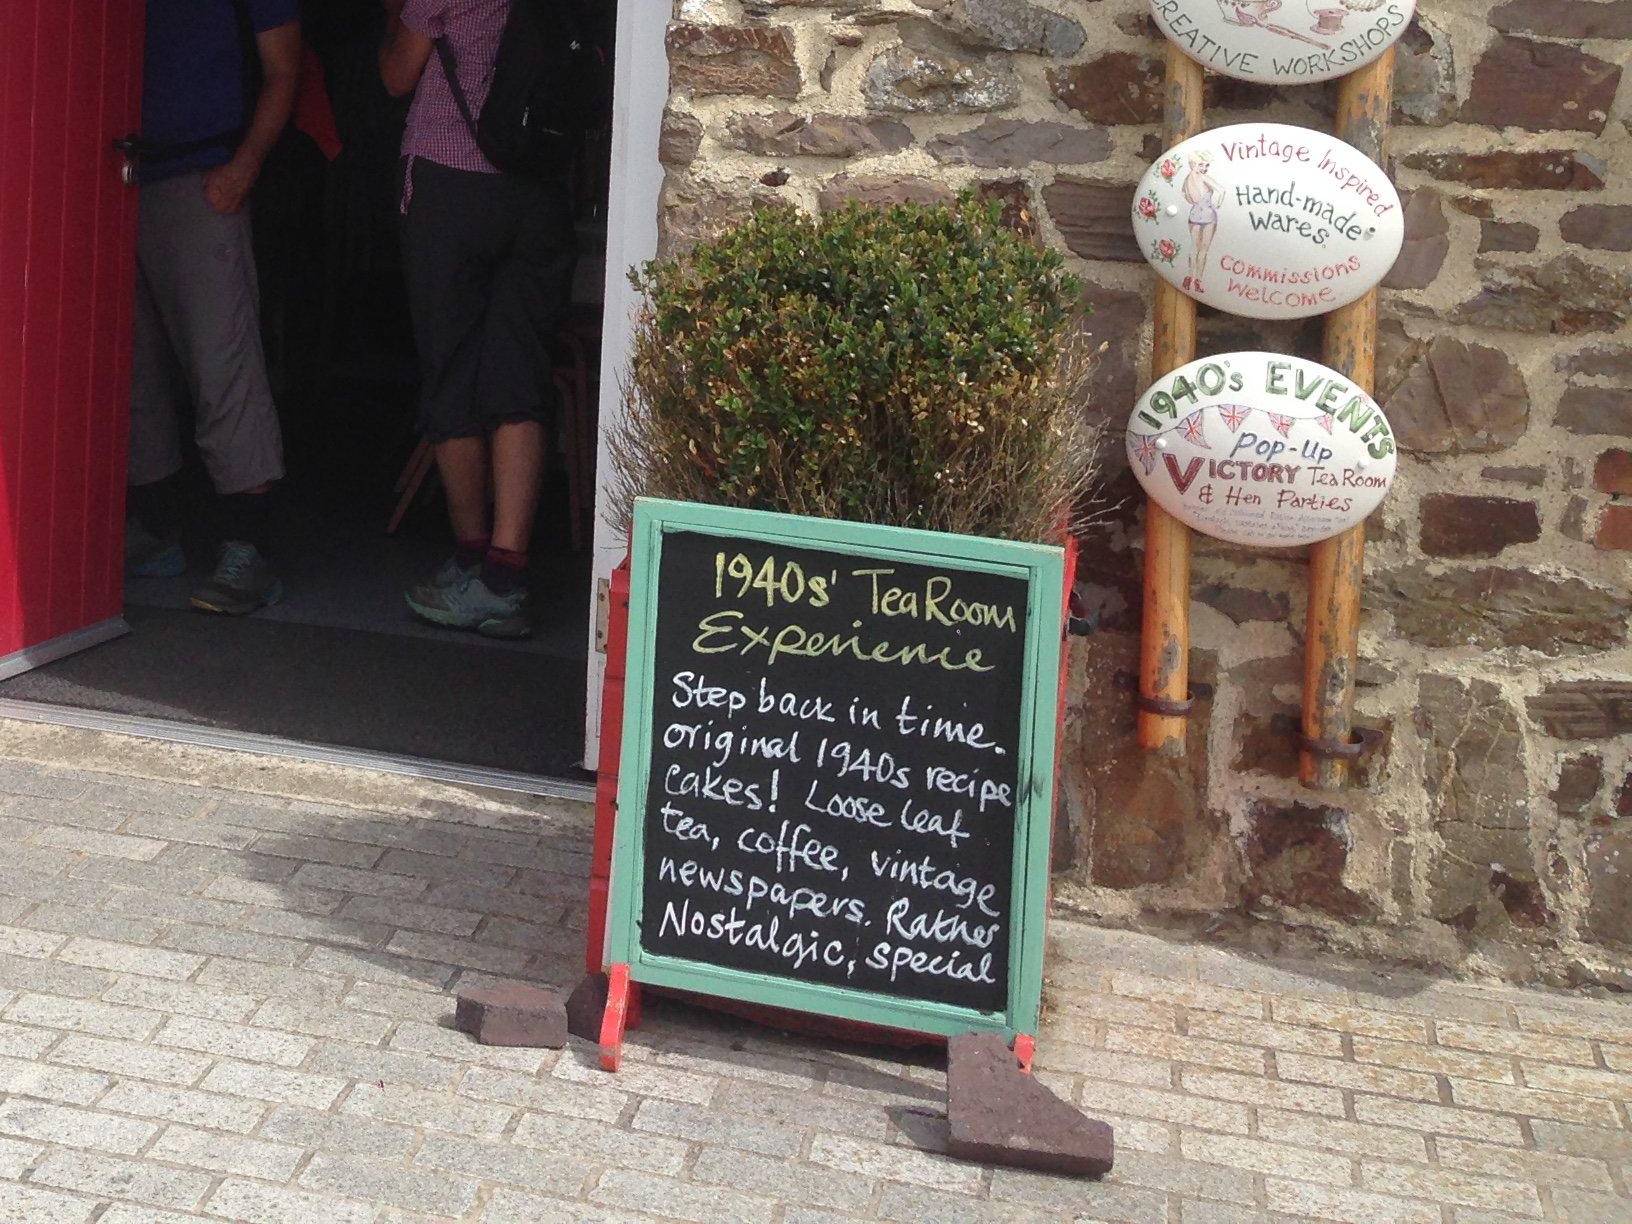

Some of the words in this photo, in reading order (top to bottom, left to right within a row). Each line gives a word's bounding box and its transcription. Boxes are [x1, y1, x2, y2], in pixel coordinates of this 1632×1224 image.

[1273, 5, 1404, 75] WORKSHOPS
[1221, 133, 1310, 162] Vintage
[1317, 149, 1393, 216] Inspired
[1236, 182, 1362, 241] Hand-made
[1265, 361, 1394, 460] EVENTS
[1162, 453, 1301, 495] VICTORY
[1309, 466, 1338, 487] Tea
[1342, 469, 1386, 488] Room
[1226, 485, 1260, 505] Hen
[1277, 490, 1353, 511] Parties
[692, 611, 995, 672] Experience
[671, 671, 746, 717] Step
[759, 676, 835, 722] back
[849, 697, 880, 729] in
[895, 696, 1006, 755] time.
[663, 722, 800, 767] original
[817, 739, 910, 788] 1940s
[926, 765, 1012, 811] recipe
[804, 779, 891, 827] Loose
[660, 801, 720, 850] tea,
[737, 820, 848, 880] coffee,
[871, 850, 1000, 917] vintage
[658, 902, 854, 978] Nostalgic,
[866, 941, 995, 984] special
